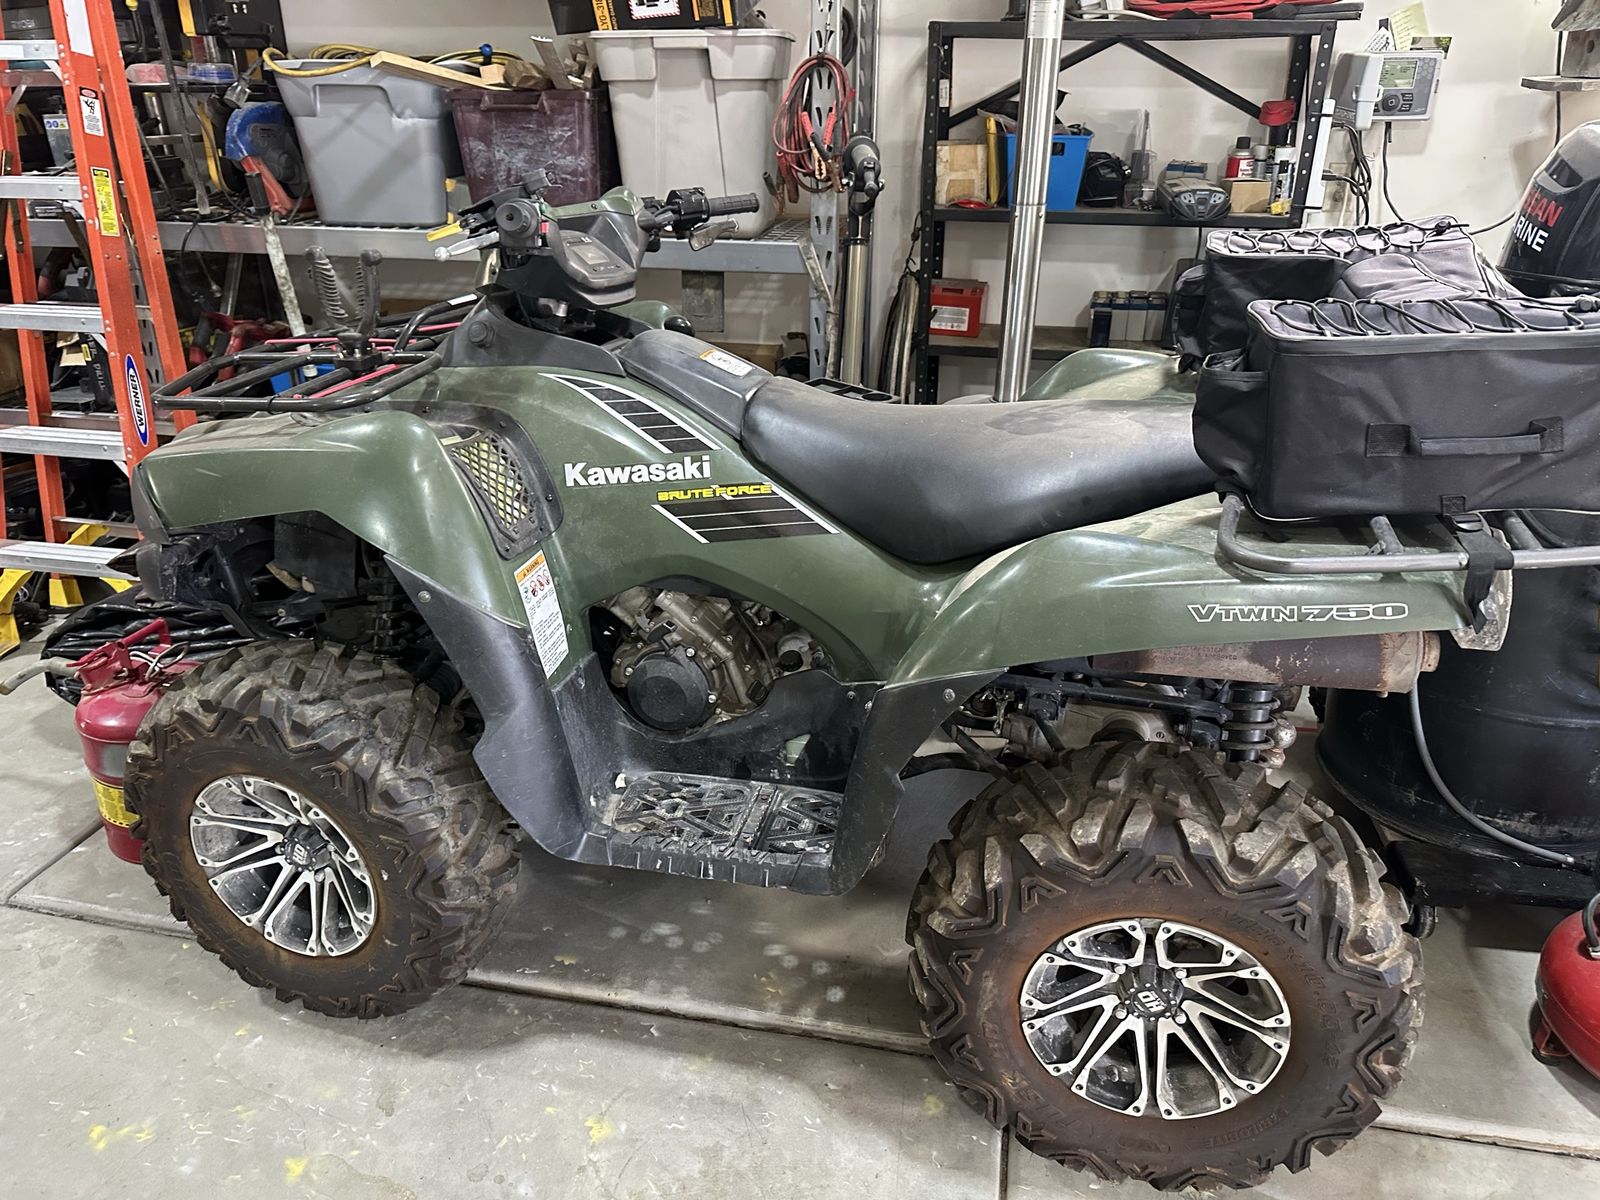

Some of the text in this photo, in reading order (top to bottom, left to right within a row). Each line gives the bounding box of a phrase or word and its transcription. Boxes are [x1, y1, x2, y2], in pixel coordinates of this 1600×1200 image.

[1513, 214, 1549, 253] RINE
[129, 373, 145, 427] WERNER
[563, 455, 711, 487] Kawasaki
[656, 483, 773, 502] BRUTE FORCE
[1187, 602, 1409, 622] VTWIN 750
